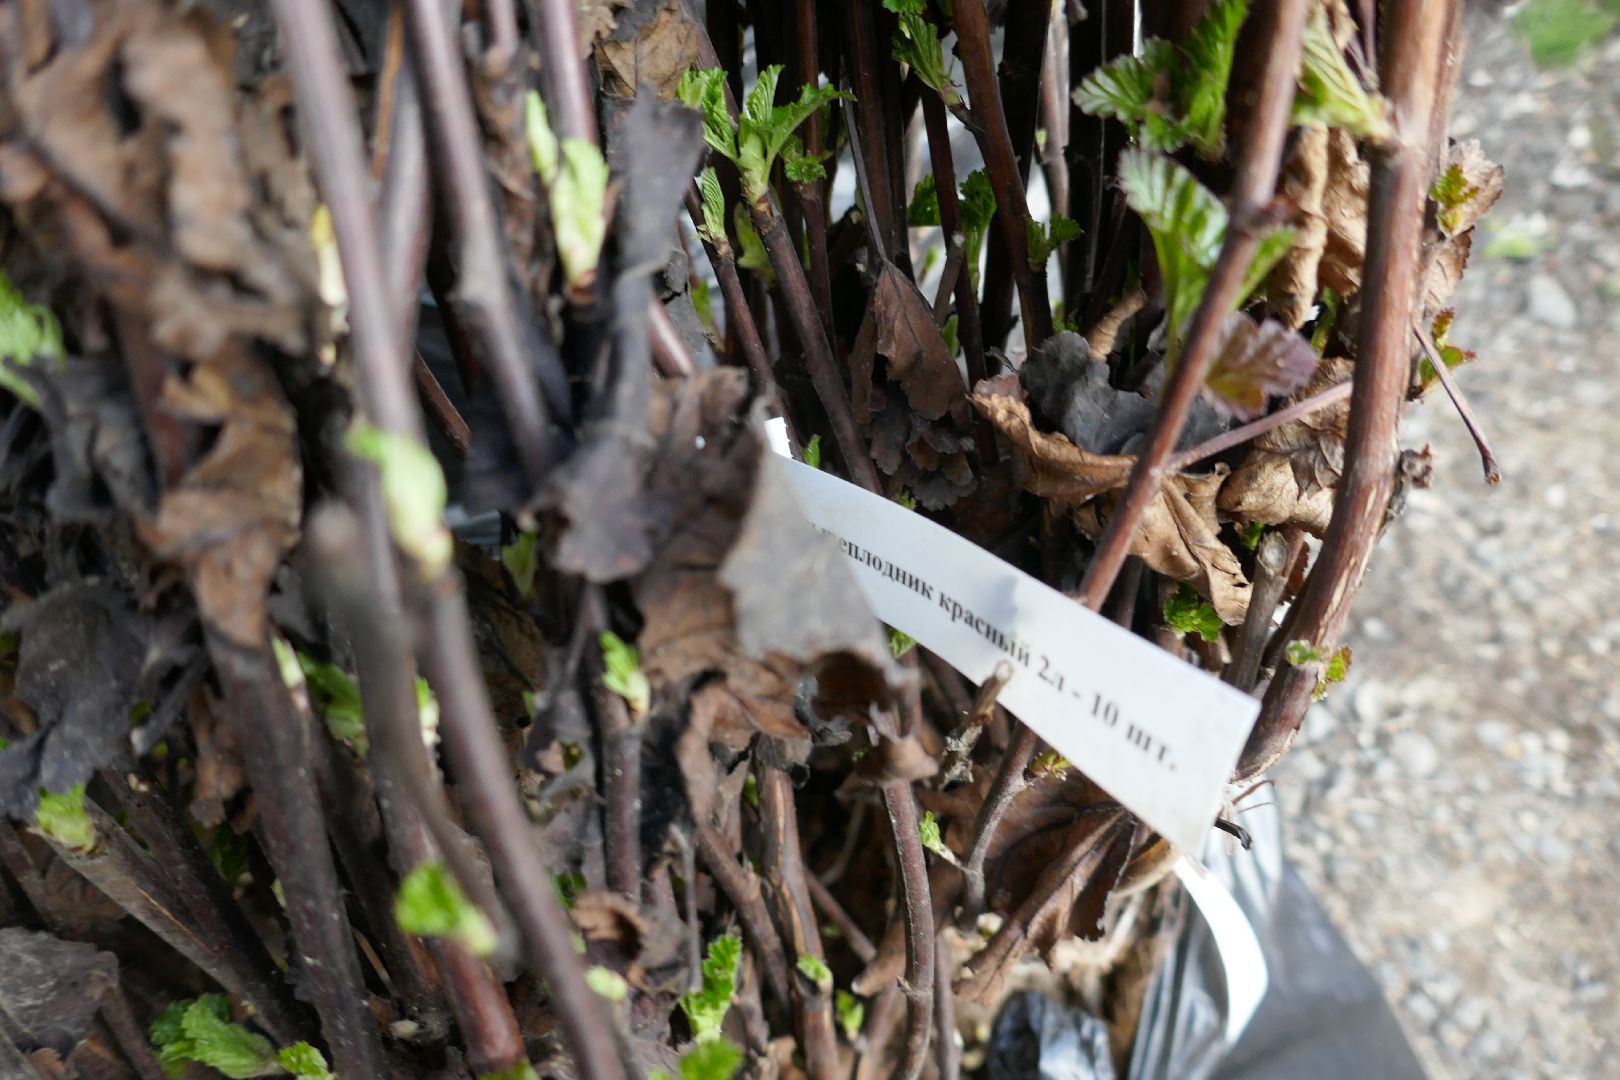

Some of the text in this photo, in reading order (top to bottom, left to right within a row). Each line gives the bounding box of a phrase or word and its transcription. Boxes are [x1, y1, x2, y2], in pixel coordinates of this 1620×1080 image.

[809, 521, 934, 601] еплодник
[938, 591, 1030, 668] красный
[1091, 693, 1119, 728] 10
[1125, 723, 1176, 771] шт.
